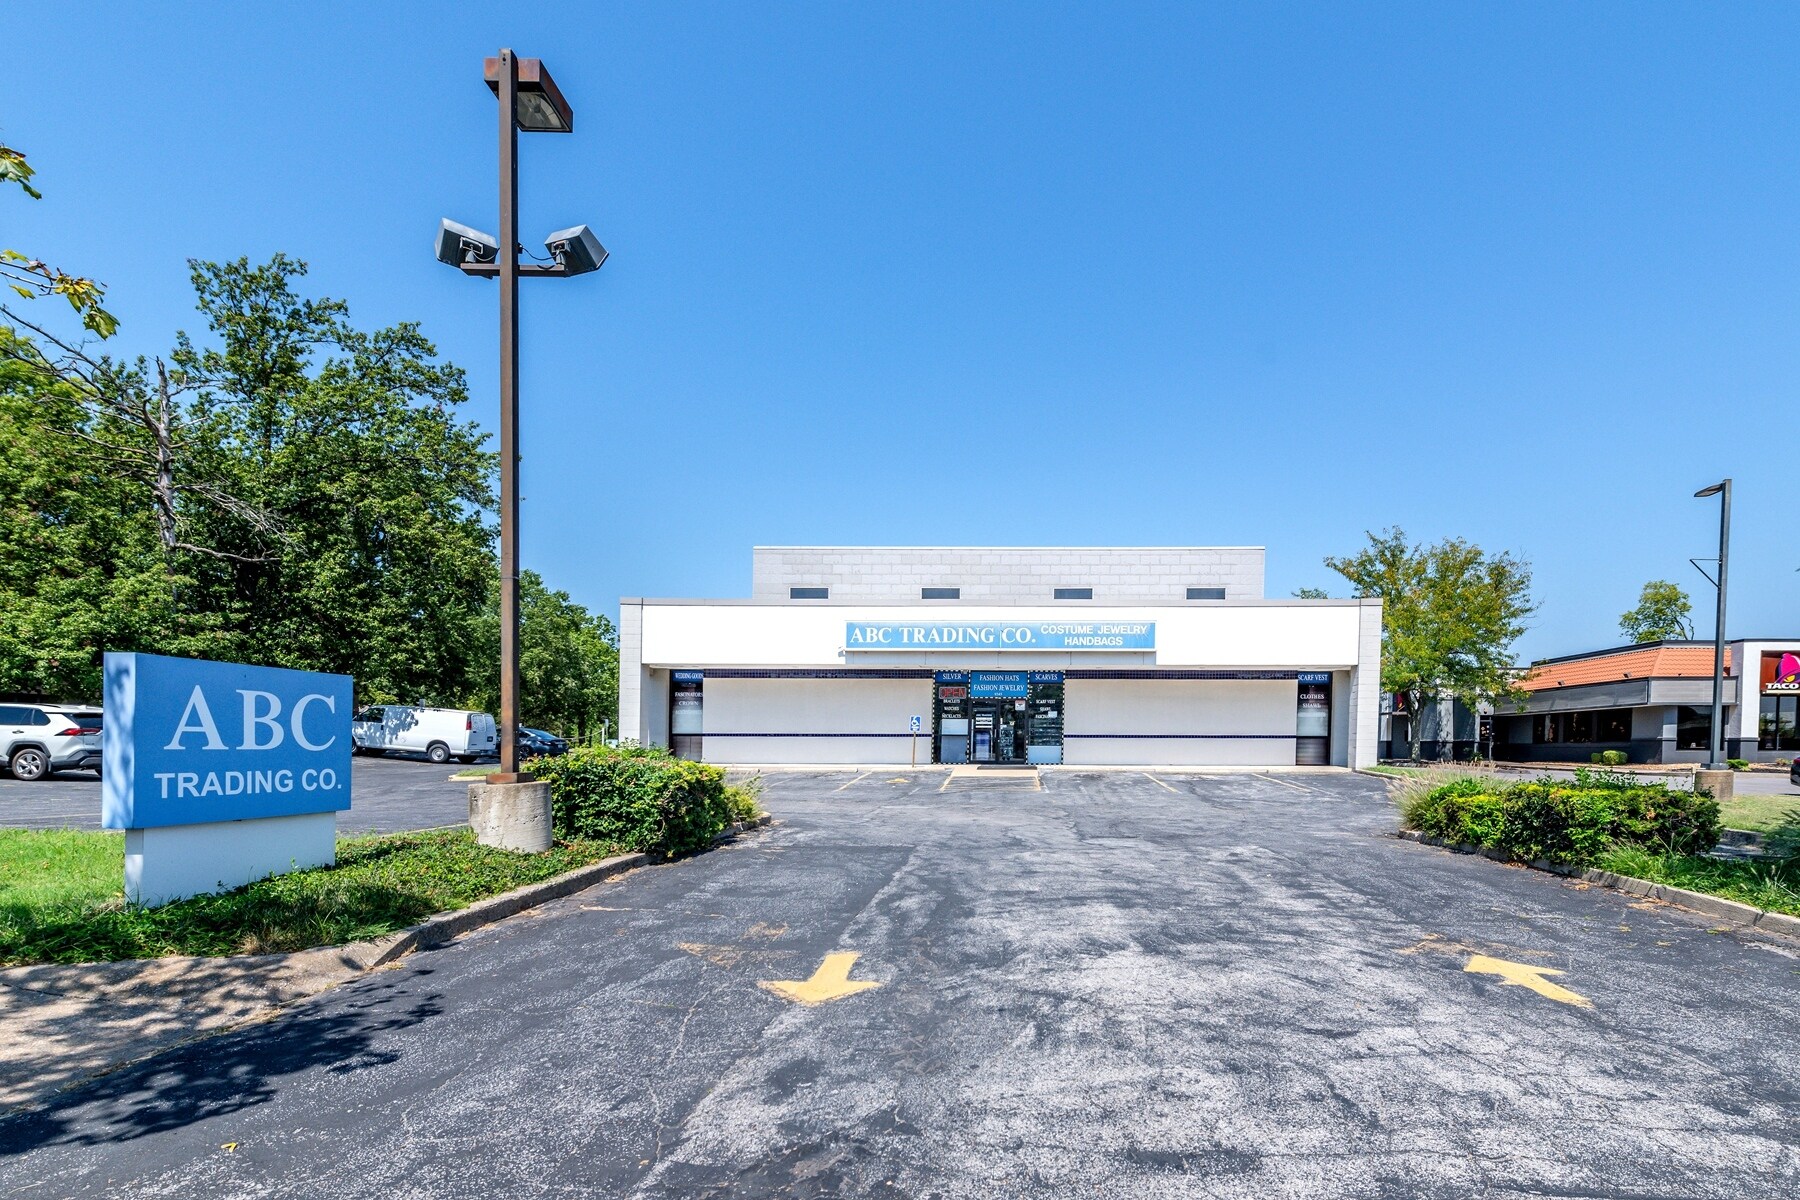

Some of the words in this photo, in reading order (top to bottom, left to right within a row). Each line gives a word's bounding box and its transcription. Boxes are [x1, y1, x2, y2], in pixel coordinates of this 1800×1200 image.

[850, 627, 892, 643] ABC
[899, 627, 995, 643] TRADING
[1001, 627, 1036, 643] CO.
[1040, 624, 1094, 635] COSTUME
[1097, 624, 1148, 636] JEWELRY
[1064, 636, 1124, 646] HANDBAGS
[1765, 682, 1800, 690] TACO
[940, 688, 966, 698] OPEN
[163, 684, 336, 752] ABC
[153, 769, 294, 799] TRADING
[301, 768, 342, 791] CO.
